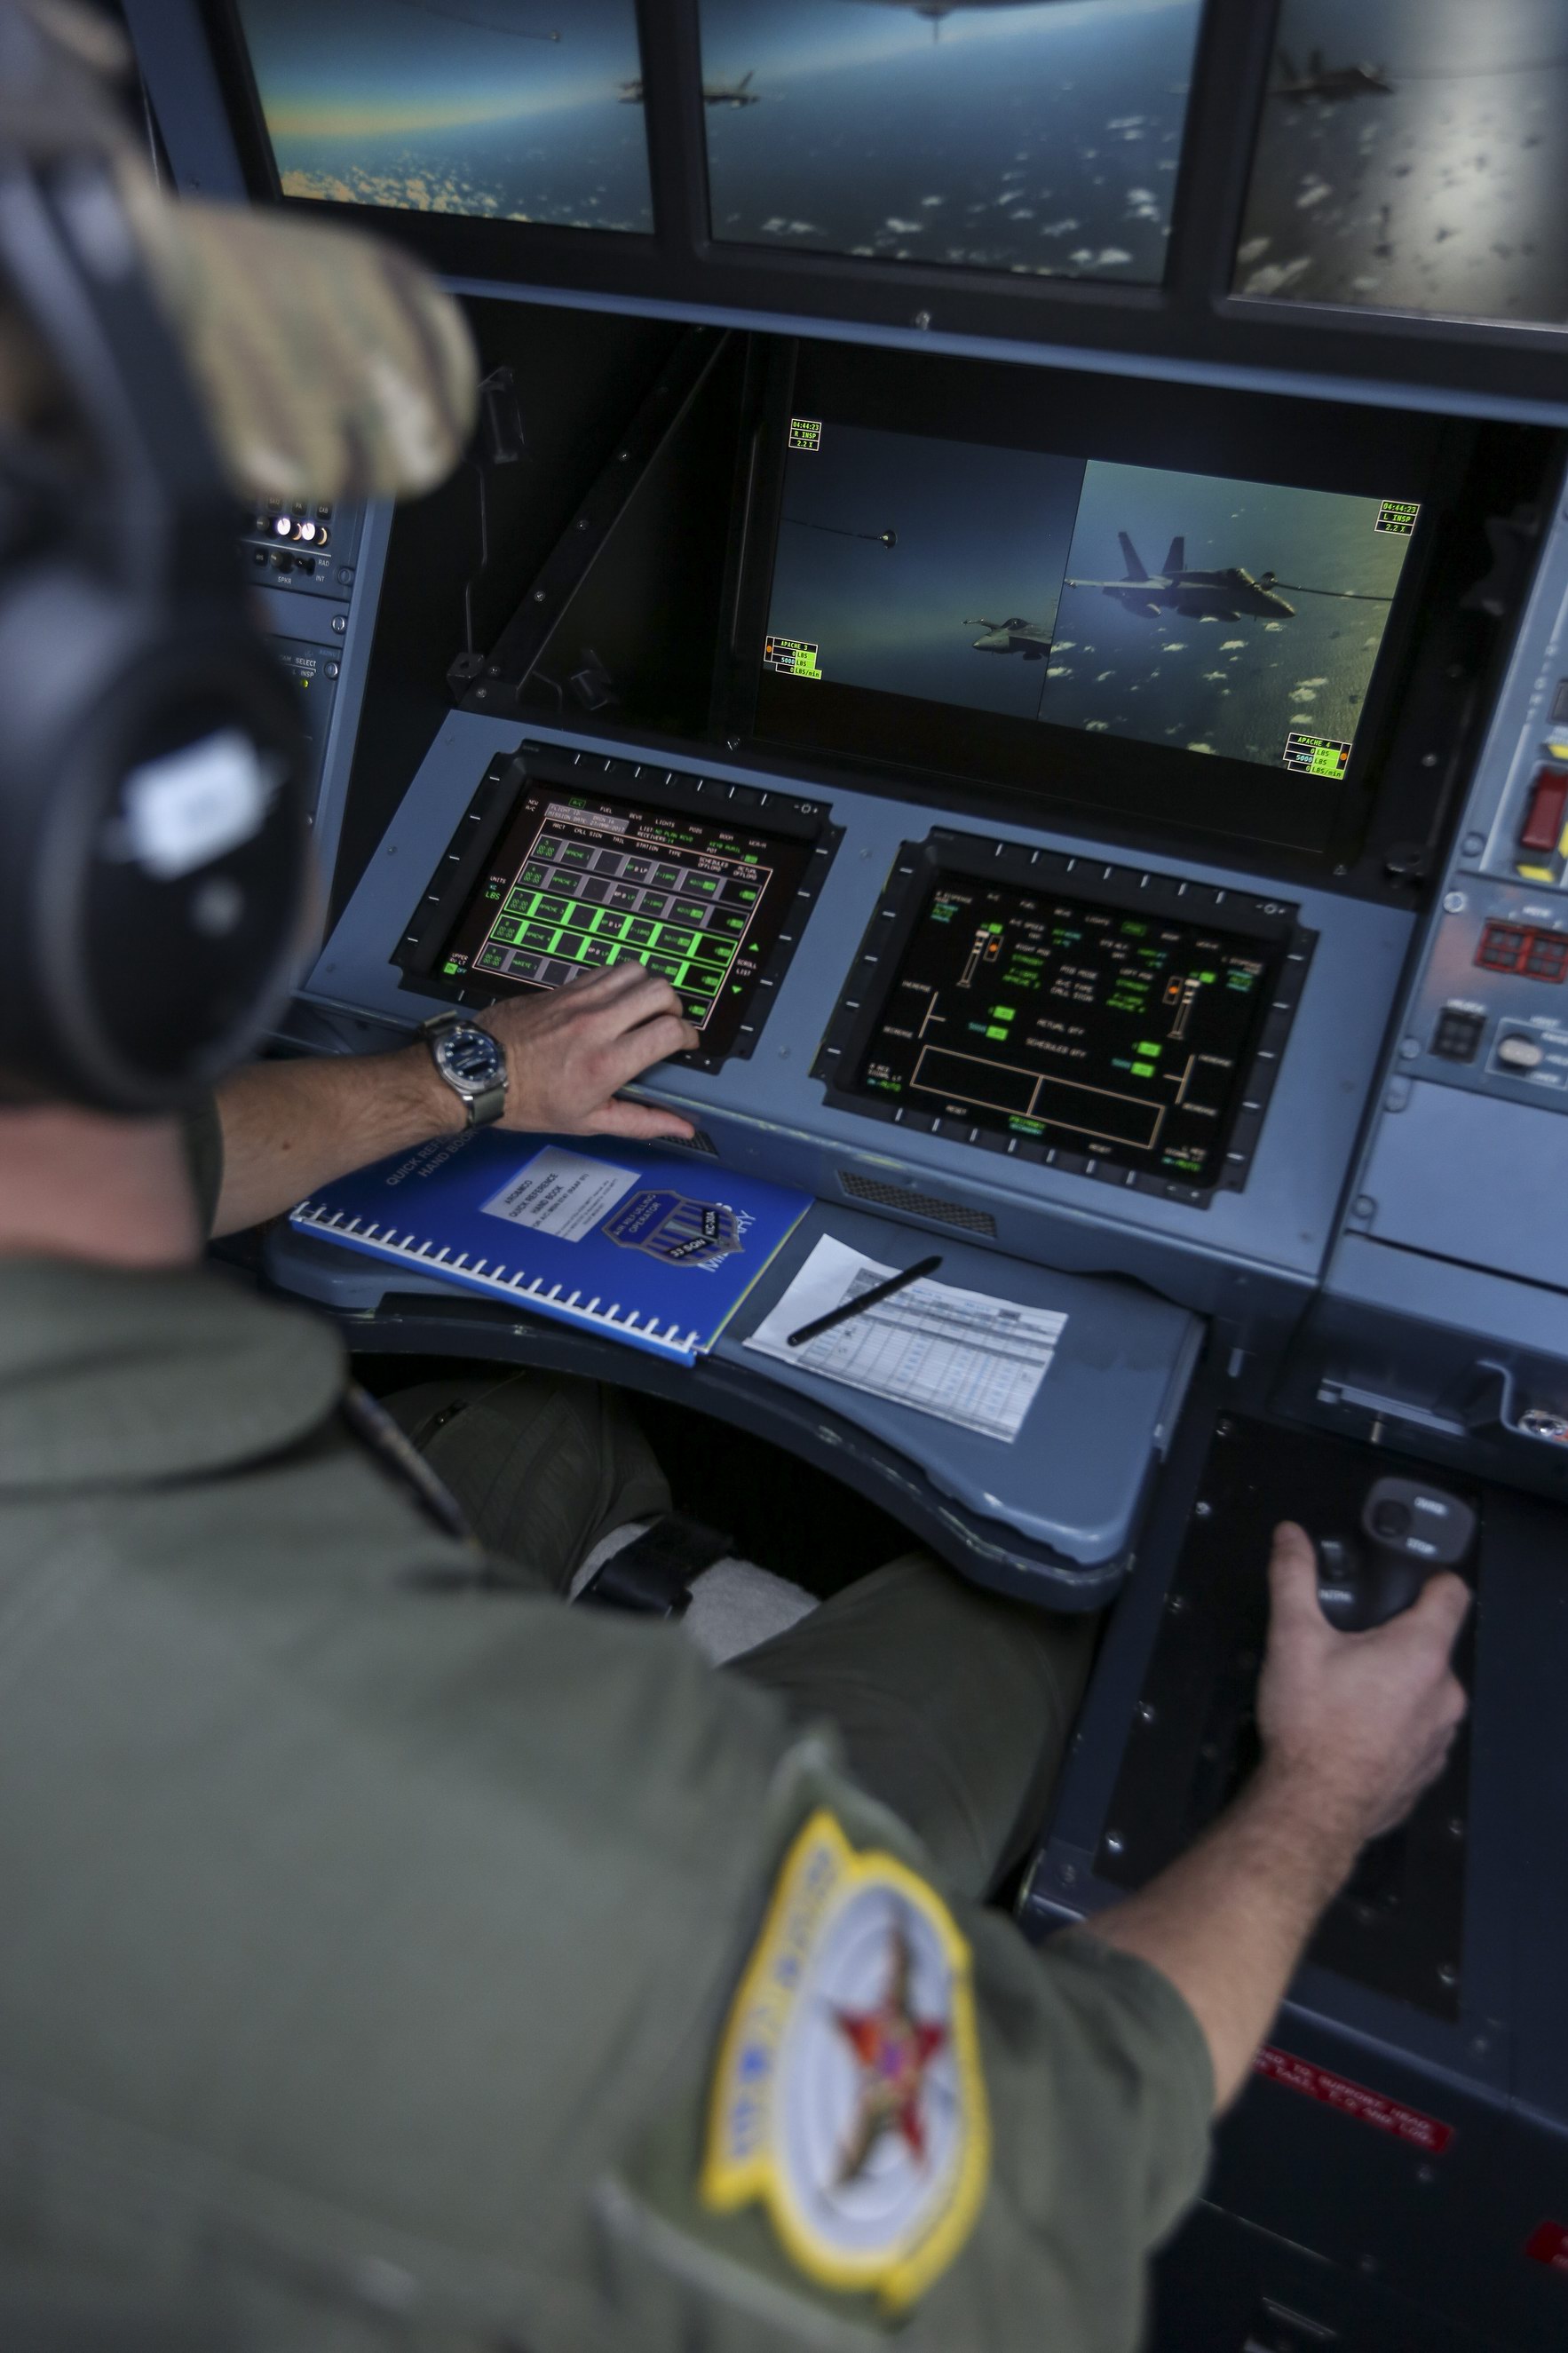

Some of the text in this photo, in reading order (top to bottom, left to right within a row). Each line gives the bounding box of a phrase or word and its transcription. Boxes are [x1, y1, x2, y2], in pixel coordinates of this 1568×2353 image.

[793, 421, 819, 431] 04:44:23
[1383, 503, 1416, 513] 04:44:23
[781, 641, 801, 650] APACHE
[296, 657, 316, 667] SELECT
[796, 668, 820, 677] LBS/min
[1297, 737, 1323, 746] APACHE
[1312, 767, 1341, 778] LBS/min
[548, 812, 571, 820] MISSION
[655, 819, 675, 828] LIGHTS
[636, 842, 660, 852] STATION
[668, 849, 682, 858] TYPE
[490, 875, 507, 884] UNITS
[485, 891, 502, 900] LBS
[737, 959, 756, 970] SCROLL
[418, 1153, 449, 1177] HAND
[385, 1158, 423, 1185] QUICK
[509, 1200, 528, 1218] QUICK
[525, 1172, 558, 1201] REFERENCE
[531, 1184, 563, 1215] HAND BOOK
[629, 1202, 661, 1233] OPERATOR
[706, 1211, 716, 1236] KC-30A
[670, 1238, 706, 1258] 33 SQN
[1319, 2074, 1384, 2108] SUPPORT
[1390, 2108, 1429, 2130] HEAD
[1362, 2107, 1392, 2125] AND
